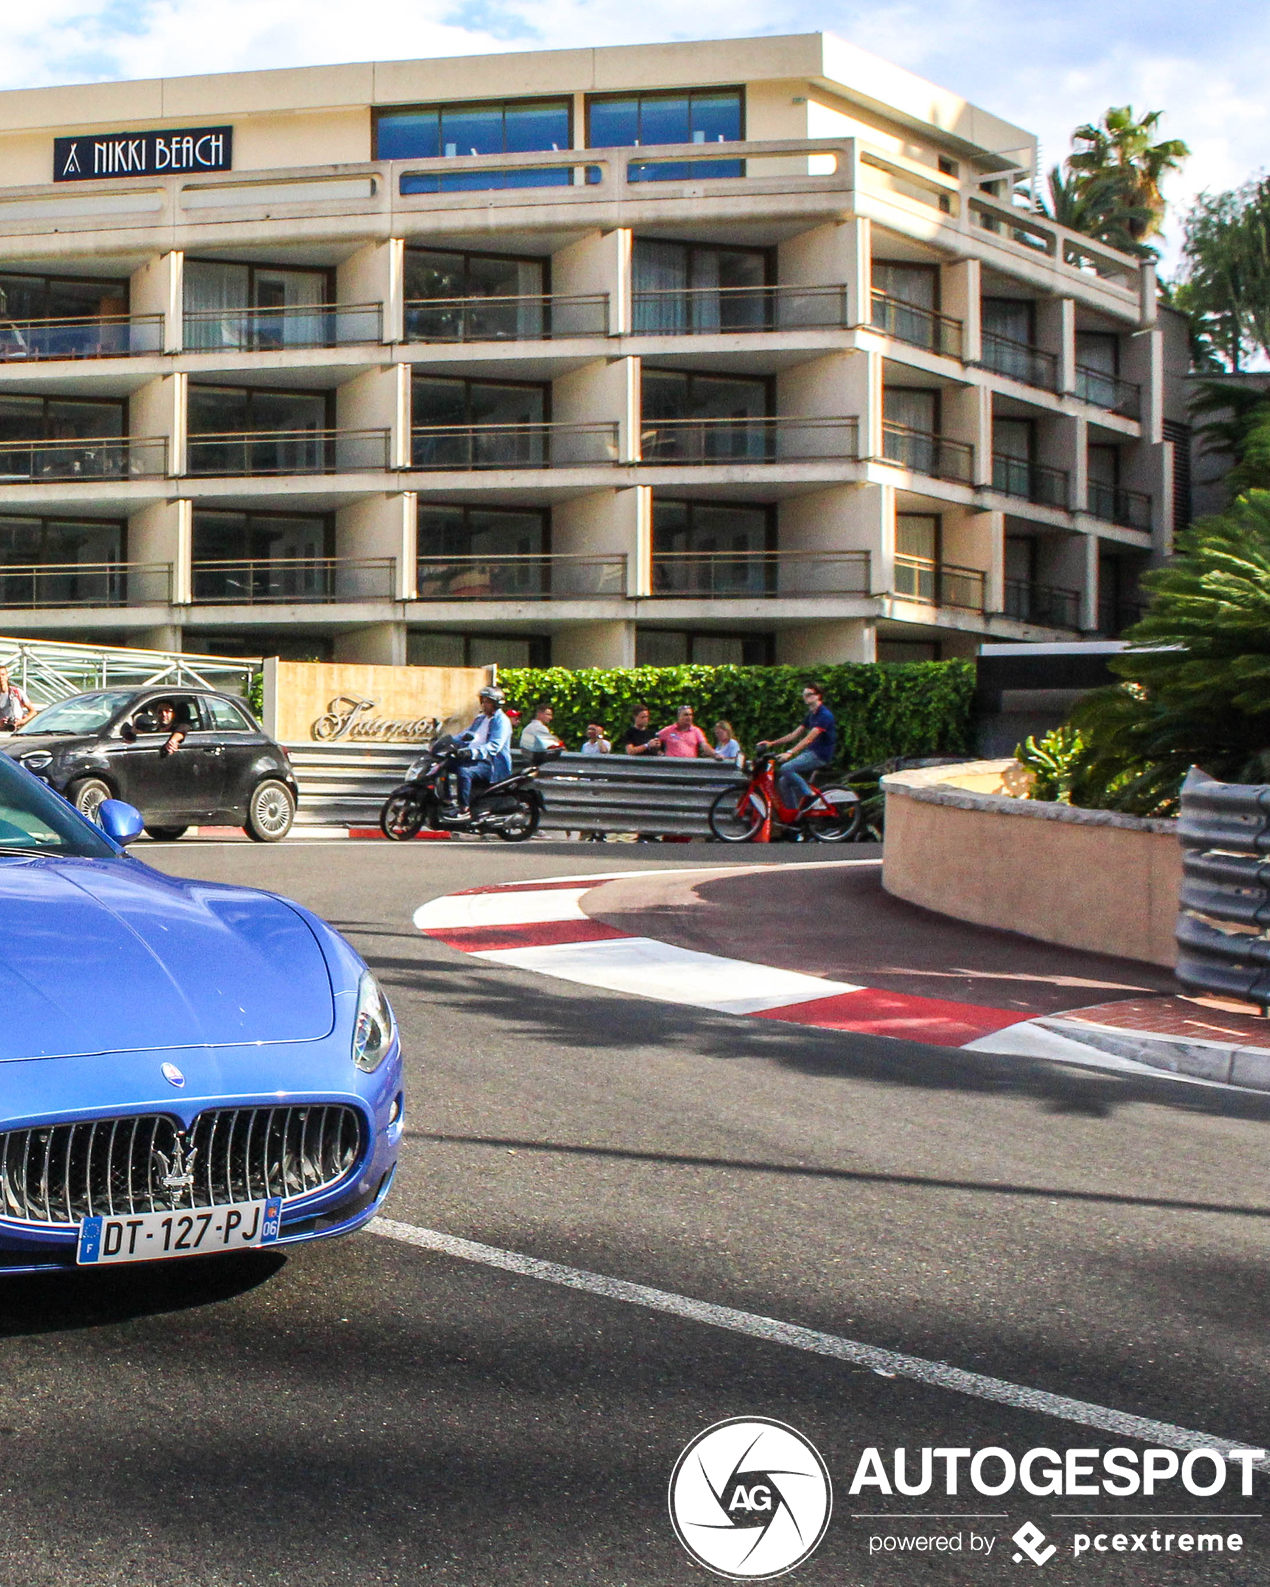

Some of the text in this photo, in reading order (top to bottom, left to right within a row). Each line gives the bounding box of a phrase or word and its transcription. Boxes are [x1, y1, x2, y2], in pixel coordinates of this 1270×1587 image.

[93, 134, 224, 174] NIKKI BEACH
[103, 1206, 260, 1256] DT-127-PJ
[262, 1220, 277, 1237] 06
[85, 1243, 94, 1254] F
